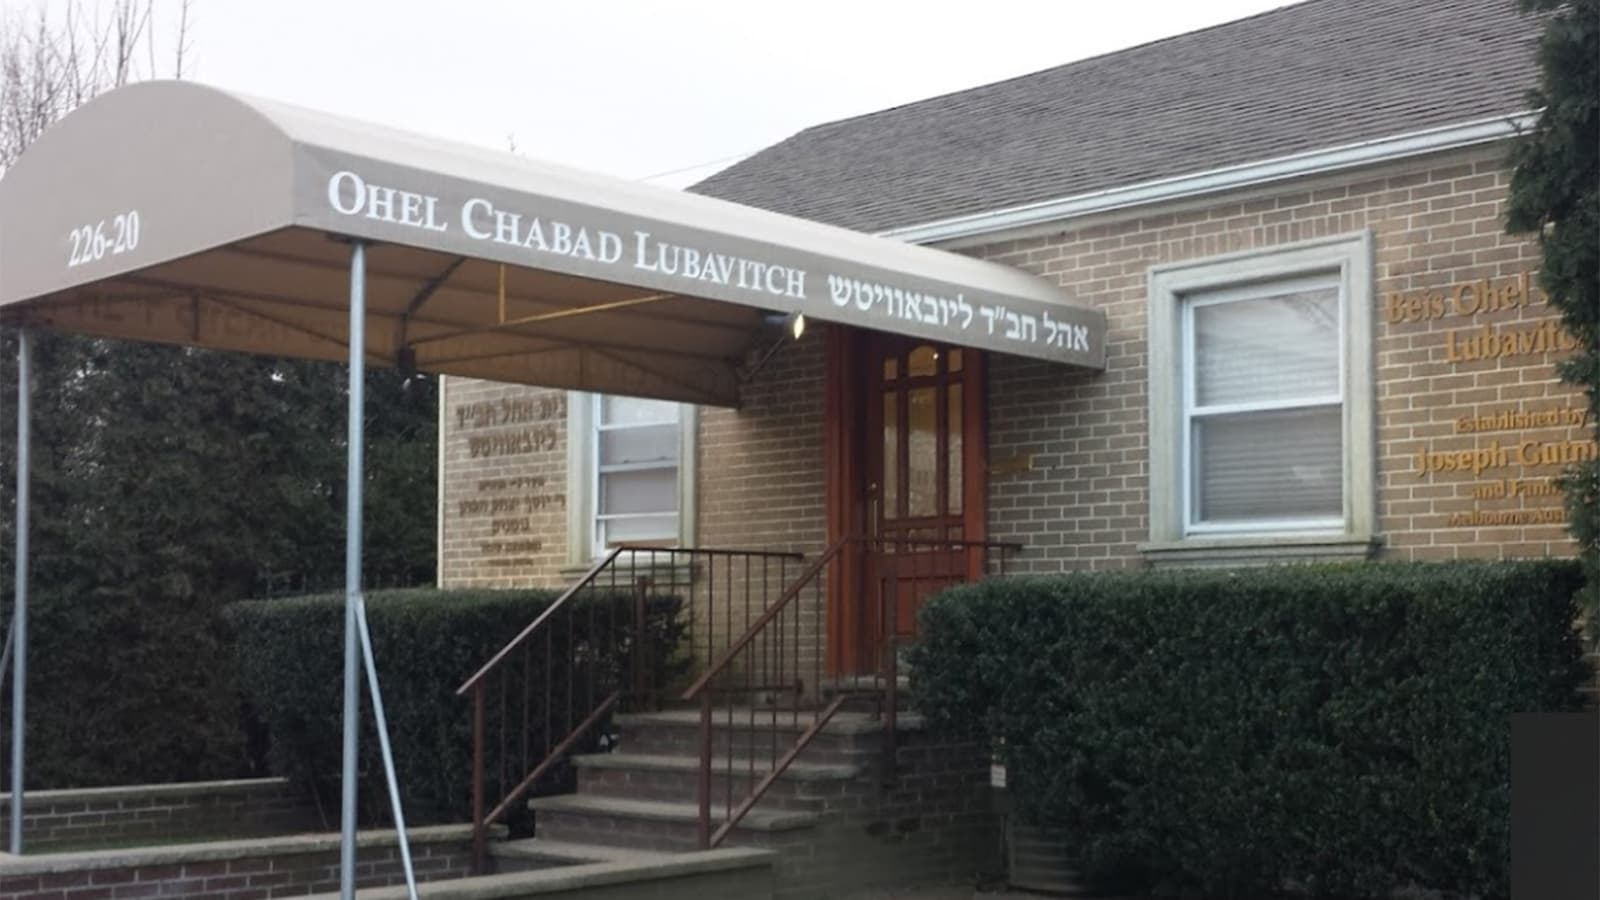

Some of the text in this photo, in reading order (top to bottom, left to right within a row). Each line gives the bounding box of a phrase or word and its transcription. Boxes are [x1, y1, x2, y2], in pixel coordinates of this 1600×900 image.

[68, 209, 139, 267] 226-20
[827, 274, 973, 329] ליובאוויטש
[1386, 288, 1446, 324] Beis
[1455, 272, 1529, 317] Ohel
[1043, 311, 1089, 350] אהל
[1566, 406, 1589, 428] by
[1416, 440, 1509, 478] Joseph
[1471, 479, 1506, 499] and
